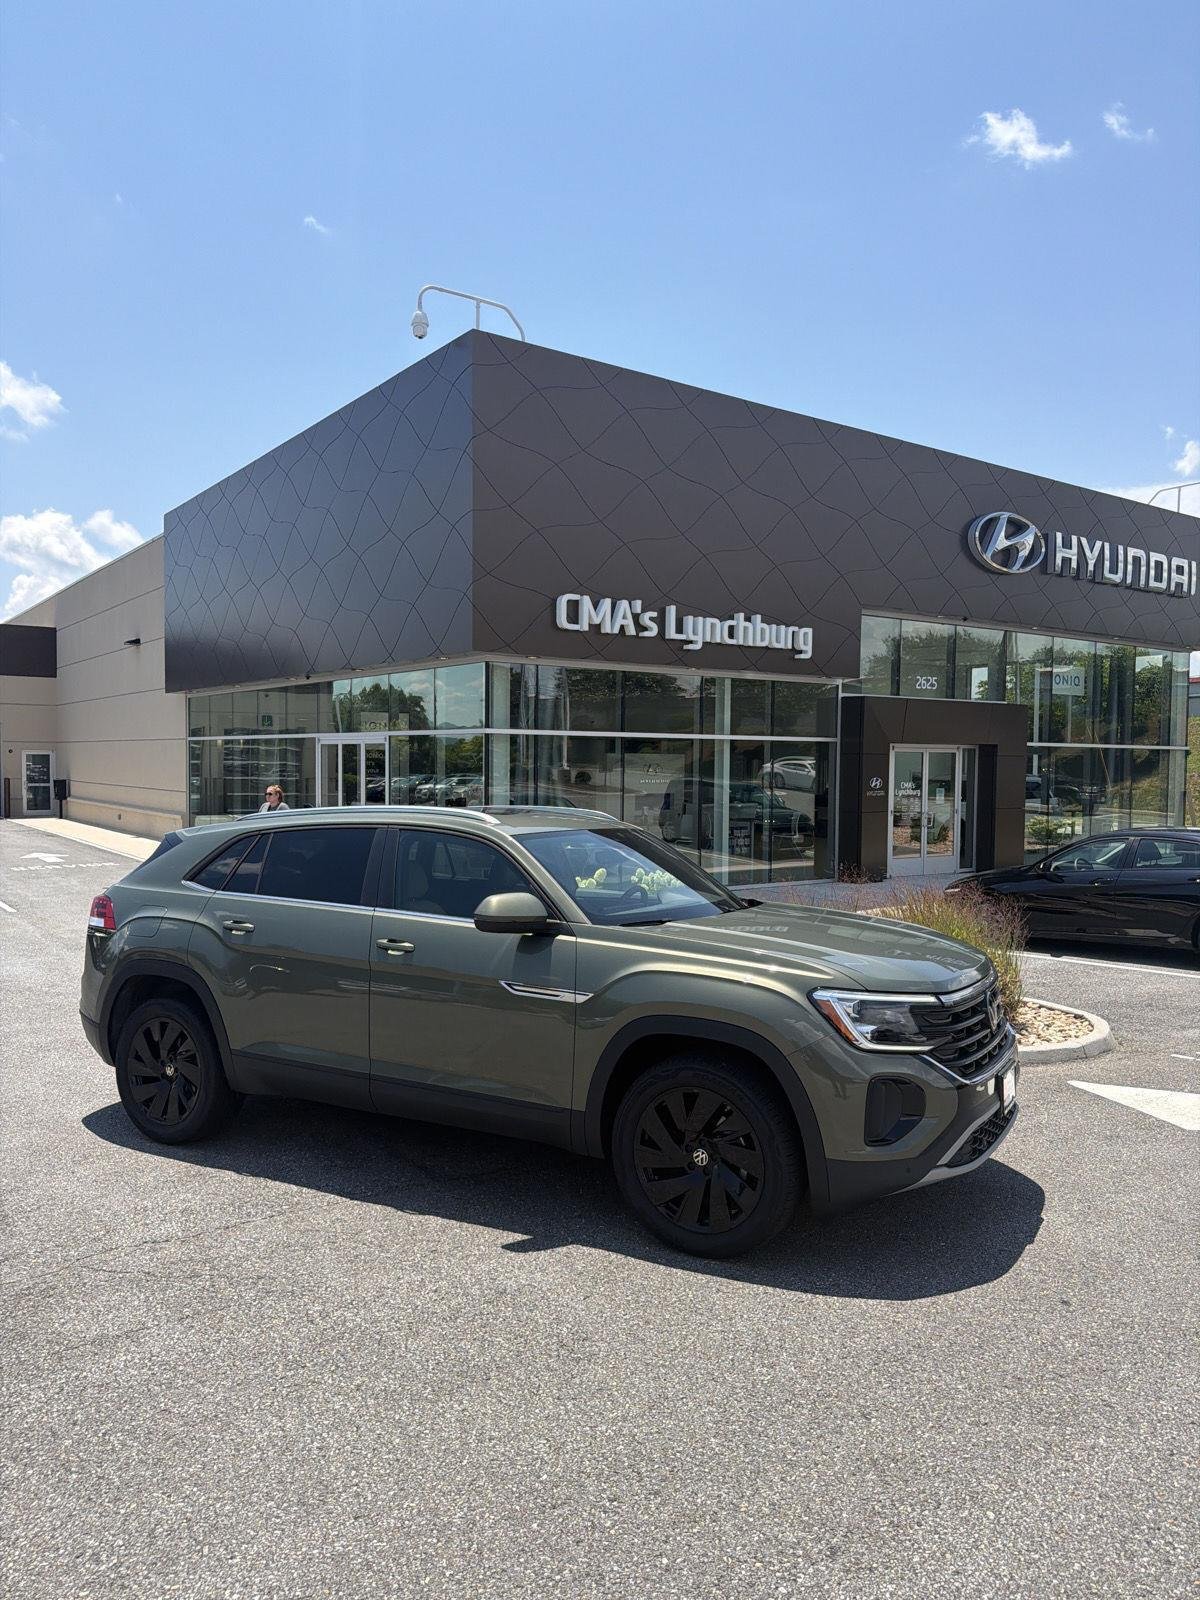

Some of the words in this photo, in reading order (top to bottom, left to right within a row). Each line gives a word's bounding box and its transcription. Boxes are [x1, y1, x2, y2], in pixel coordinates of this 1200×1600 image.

[1051, 531, 1197, 598] HYUNDAI
[556, 593, 659, 637] CMA's
[665, 604, 813, 659] Lynchburg
[916, 676, 938, 690] 2625
[1051, 673, 1081, 687] ONIQ
[895, 789, 921, 797] Lynchburg
